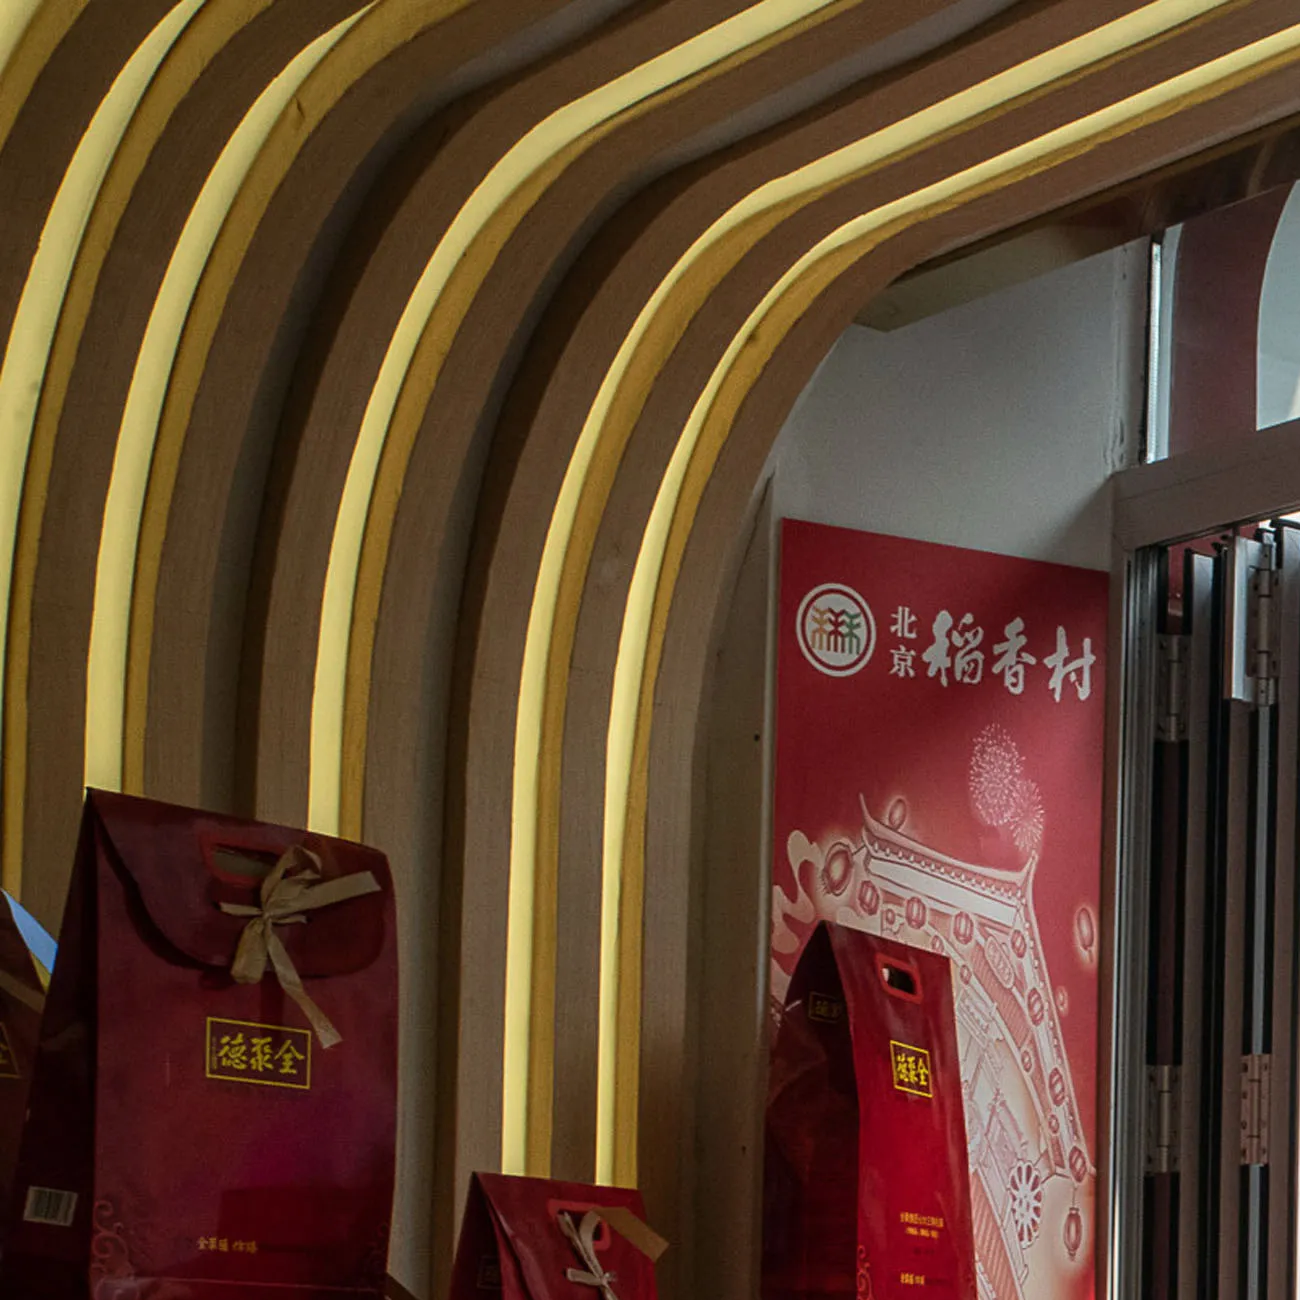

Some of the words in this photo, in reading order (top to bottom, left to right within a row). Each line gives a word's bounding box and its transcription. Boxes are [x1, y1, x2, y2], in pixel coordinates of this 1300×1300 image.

[889, 605, 918, 678] 北京
[921, 610, 1097, 703] 稻香村
